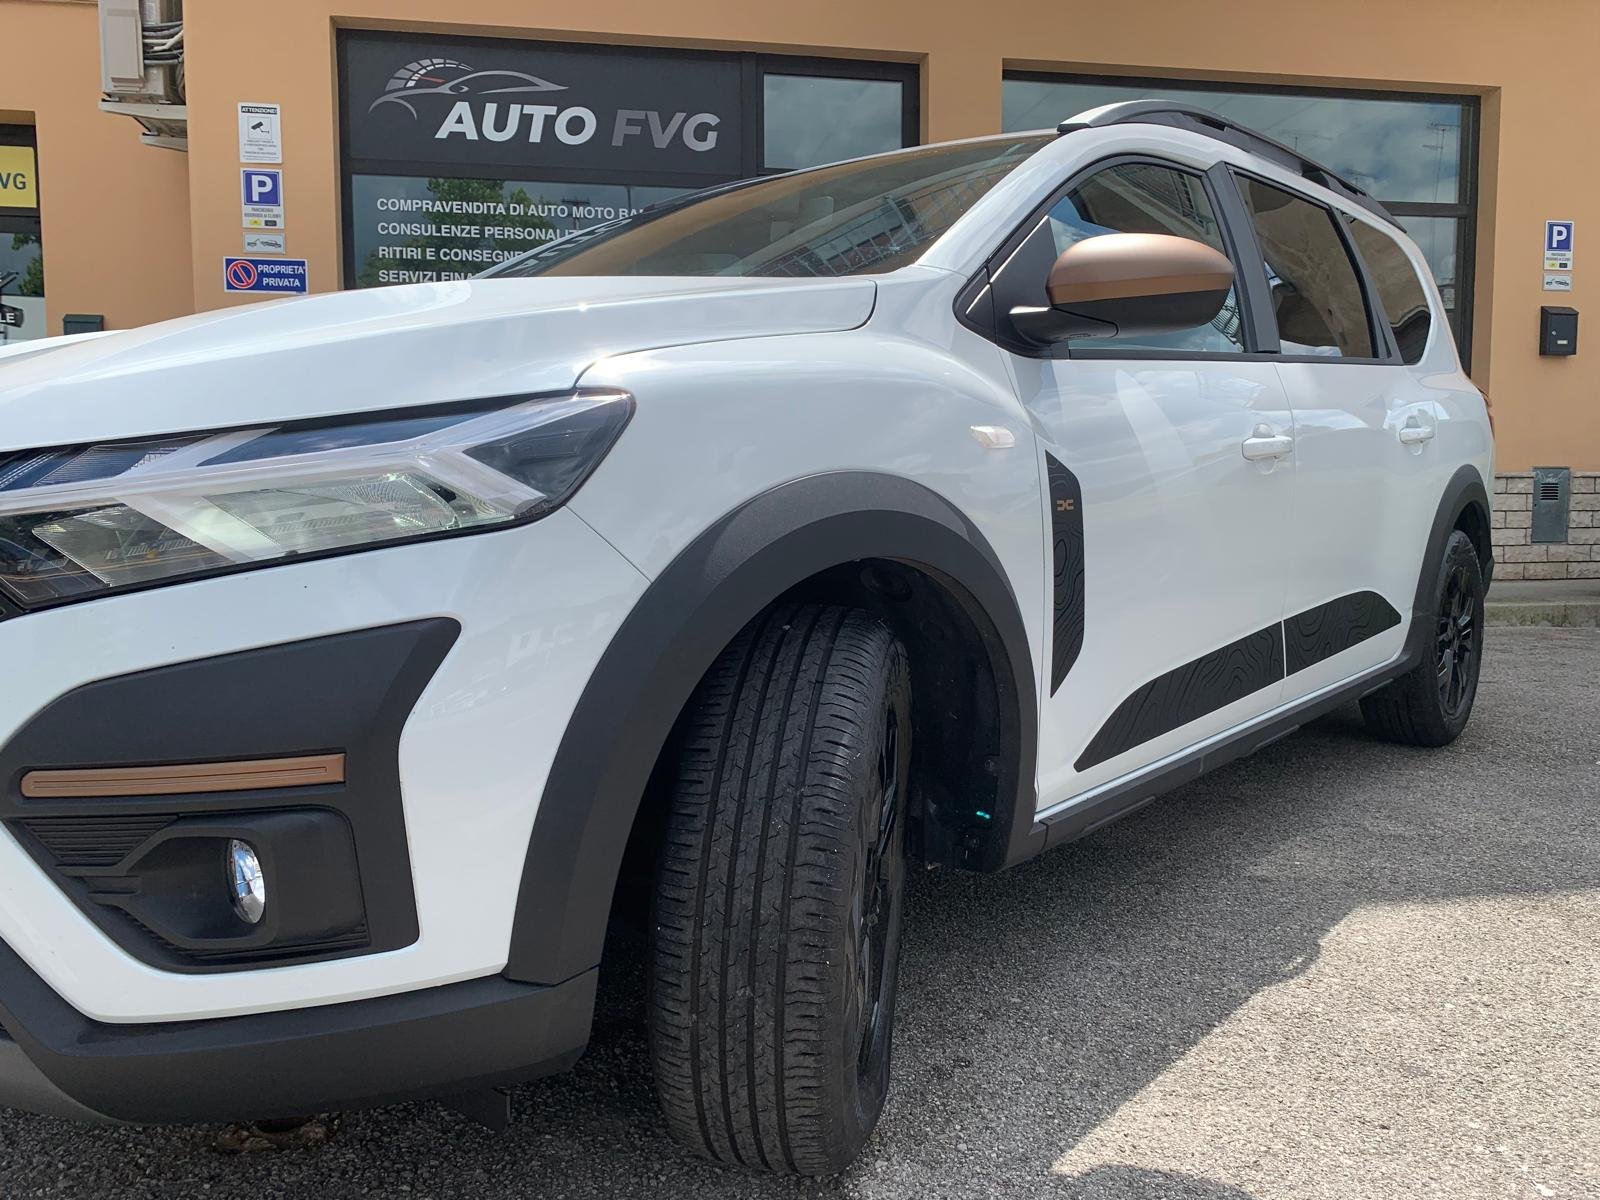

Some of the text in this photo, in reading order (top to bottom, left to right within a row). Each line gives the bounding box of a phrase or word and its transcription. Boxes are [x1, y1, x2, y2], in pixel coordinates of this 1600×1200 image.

[435, 101, 721, 151] AUTO FVG
[251, 175, 273, 202] P
[377, 199, 506, 215] COMPRAVENDITA
[509, 204, 524, 215] DI
[527, 205, 568, 217] AUTO
[572, 206, 614, 219] MOTO
[377, 223, 480, 237] CONSULENZE
[1552, 226, 1567, 247] P
[378, 247, 421, 259] RITIRI
[426, 248, 435, 259] E
[262, 278, 300, 287] PRIVATA
[378, 270, 436, 282] SERVIZI
